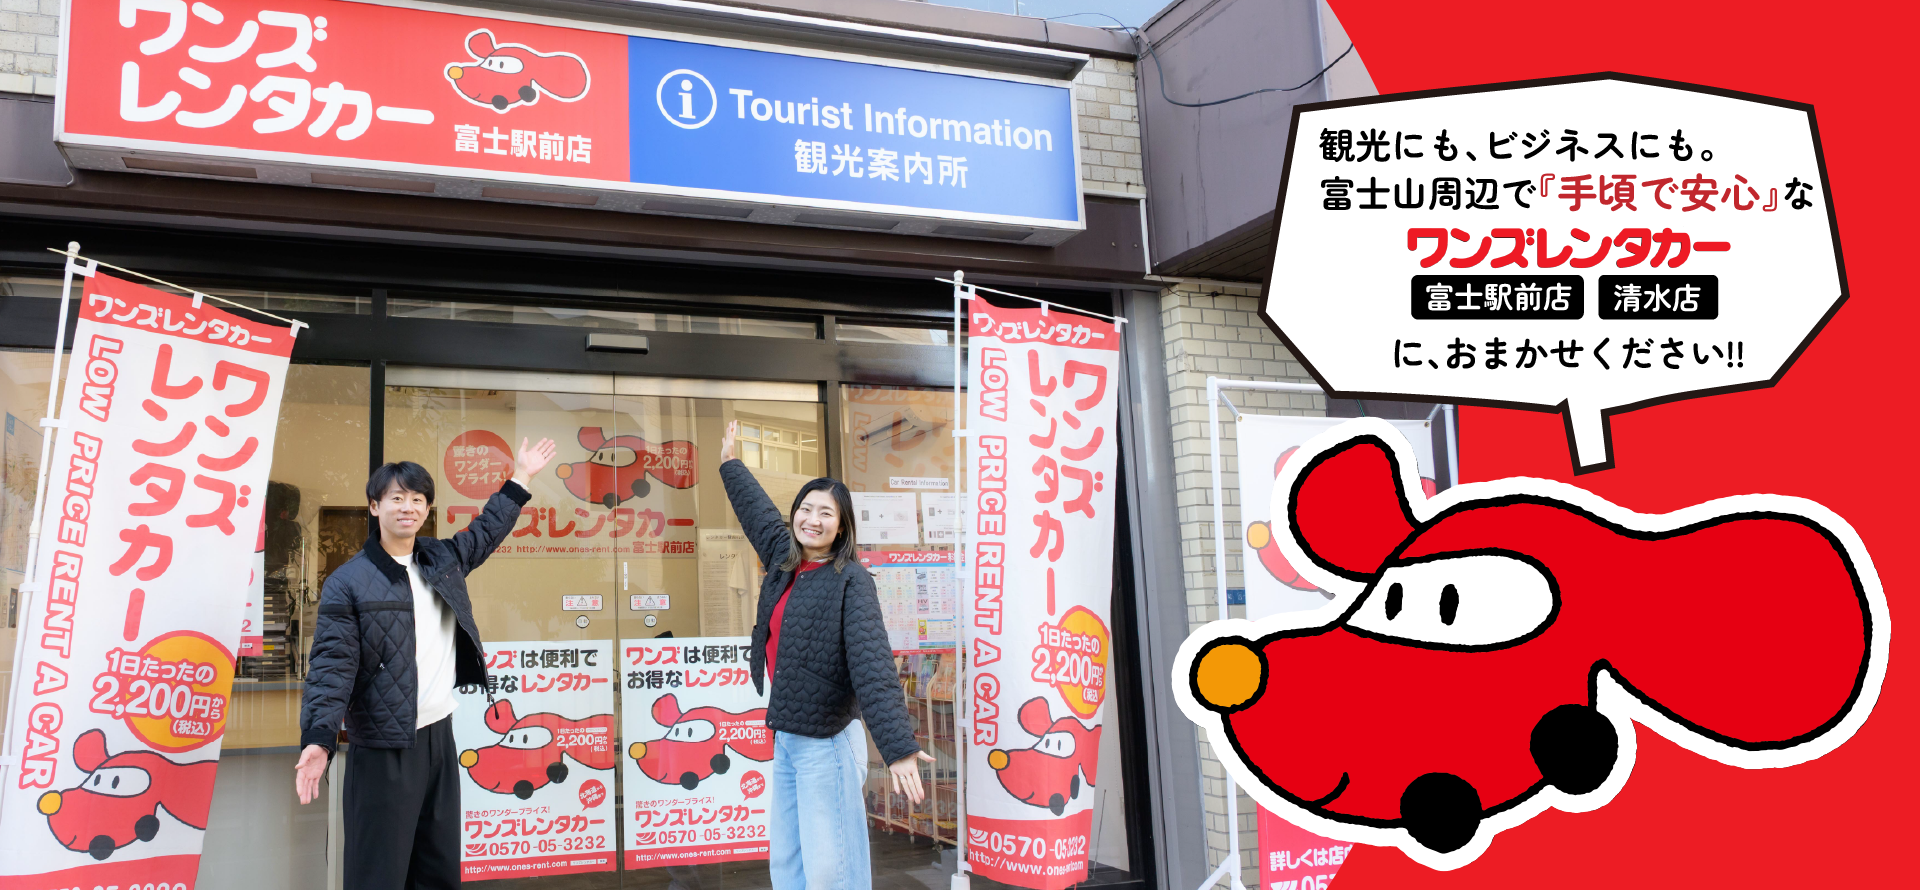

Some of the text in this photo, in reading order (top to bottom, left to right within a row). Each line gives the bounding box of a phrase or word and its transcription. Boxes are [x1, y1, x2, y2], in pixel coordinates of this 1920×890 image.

[119, 0, 328, 72] ワンズ
[120, 61, 435, 141] レンタカー
[729, 88, 1053, 152] Tourist Information
[454, 123, 592, 164] 富士駅前店
[794, 138, 969, 189] 観光案内所
[88, 293, 272, 345] ワンズレンタカー
[972, 312, 1105, 345] ワンズレンタカー
[185, 360, 271, 536] ワンズ
[453, 445, 489, 457] 驚きの
[646, 446, 687, 454] 1日たったの
[1060, 360, 1107, 519] ワンズ
[455, 458, 501, 472] ワンダー
[456, 471, 506, 485] プライス!
[109, 343, 204, 642] レンタカー
[890, 478, 900, 486] Car
[919, 479, 949, 487] Information
[1027, 349, 1065, 616] レンタカー
[447, 505, 695, 538] ワズレンタカー
[19, 334, 124, 789] LOW PRICE RENT A CAR
[632, 541, 694, 554] 富士駅前店
[974, 347, 1008, 746] LOW PRICE RENT A CAR
[1041, 625, 1100, 654] 1日たったの
[109, 650, 214, 683] 1日たったの
[483, 648, 599, 669] ンズは便利で
[627, 667, 765, 690] お得なレンタカ
[173, 719, 211, 736] (税込)
[465, 815, 605, 839] ワンズレンタカー
[635, 805, 766, 828] ワンズレンタカー
[464, 860, 567, 874] http://www.ones-rent.com
[635, 848, 731, 862] http://www.ones-rent.com
[1270, 844, 1353, 872] 詳しくは店
